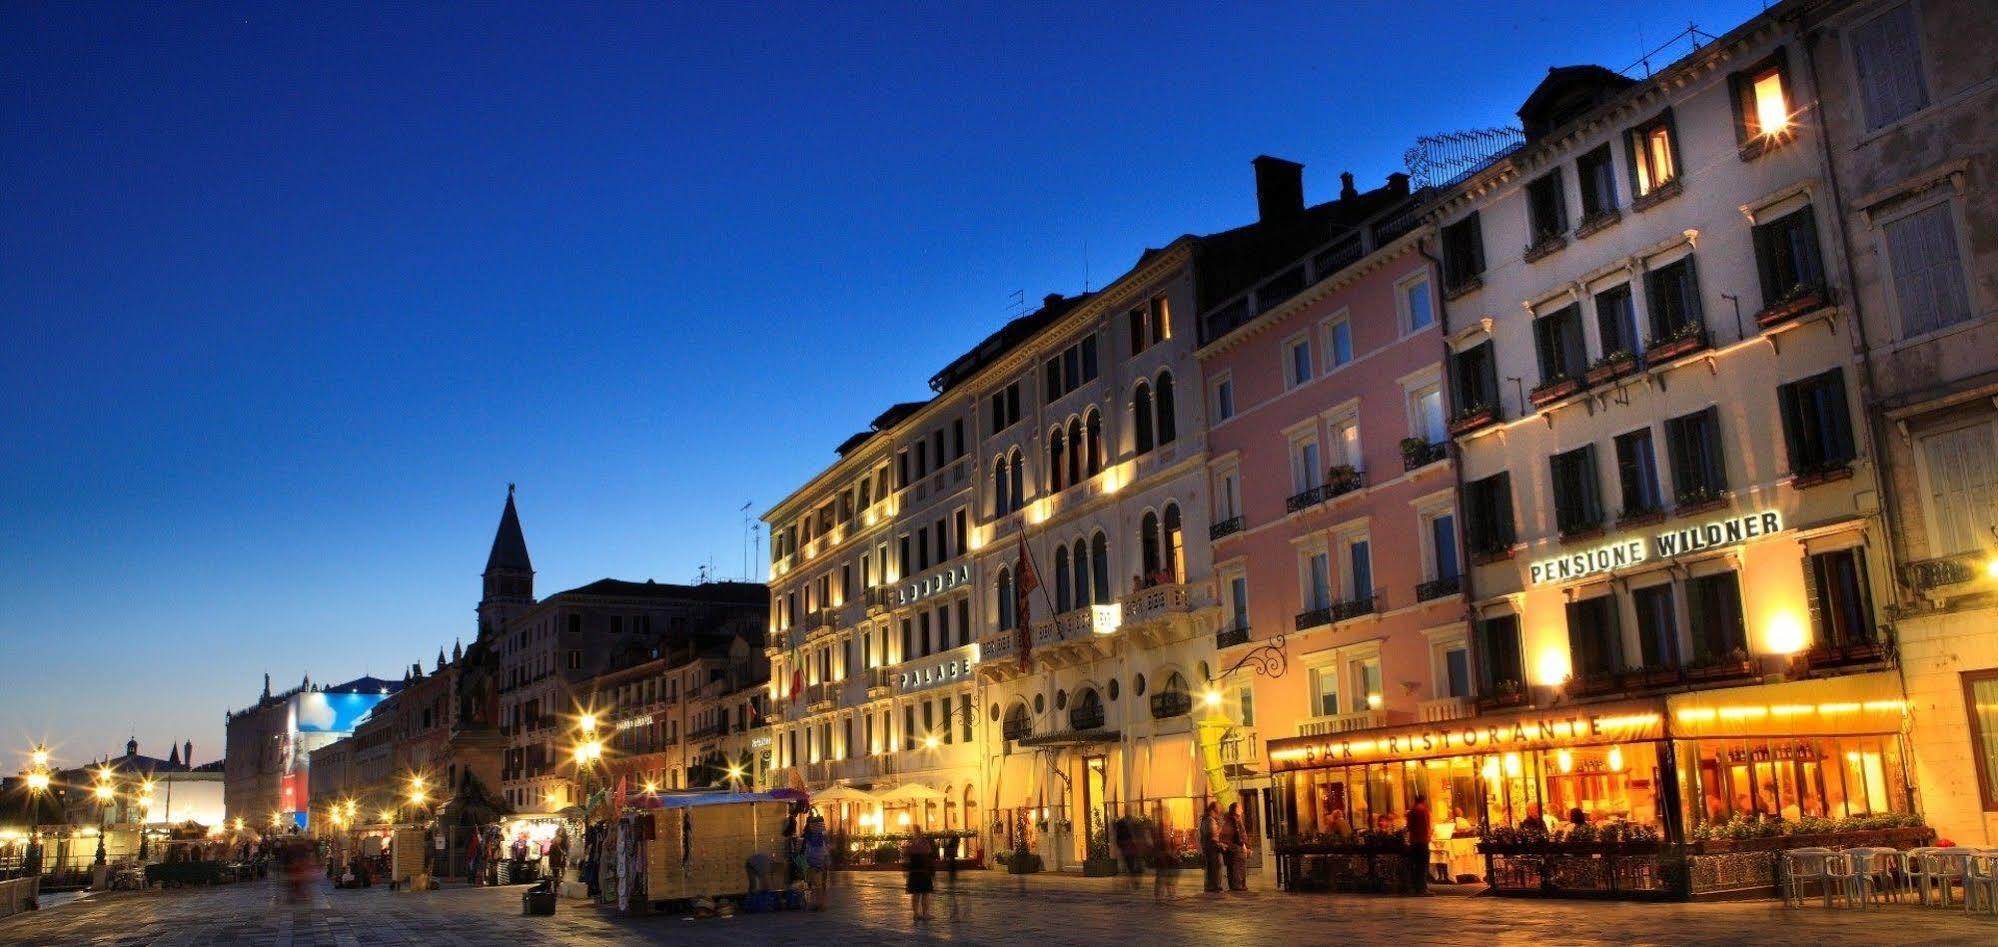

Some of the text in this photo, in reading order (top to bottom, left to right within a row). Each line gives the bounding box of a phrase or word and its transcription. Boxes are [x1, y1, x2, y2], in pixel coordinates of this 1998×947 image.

[1531, 511, 1780, 583] PENSIONE WILDNER
[899, 565, 968, 604] LONDRA
[900, 658, 971, 688] PALACE
[1305, 714, 1602, 763] BAR RISTORANTE
